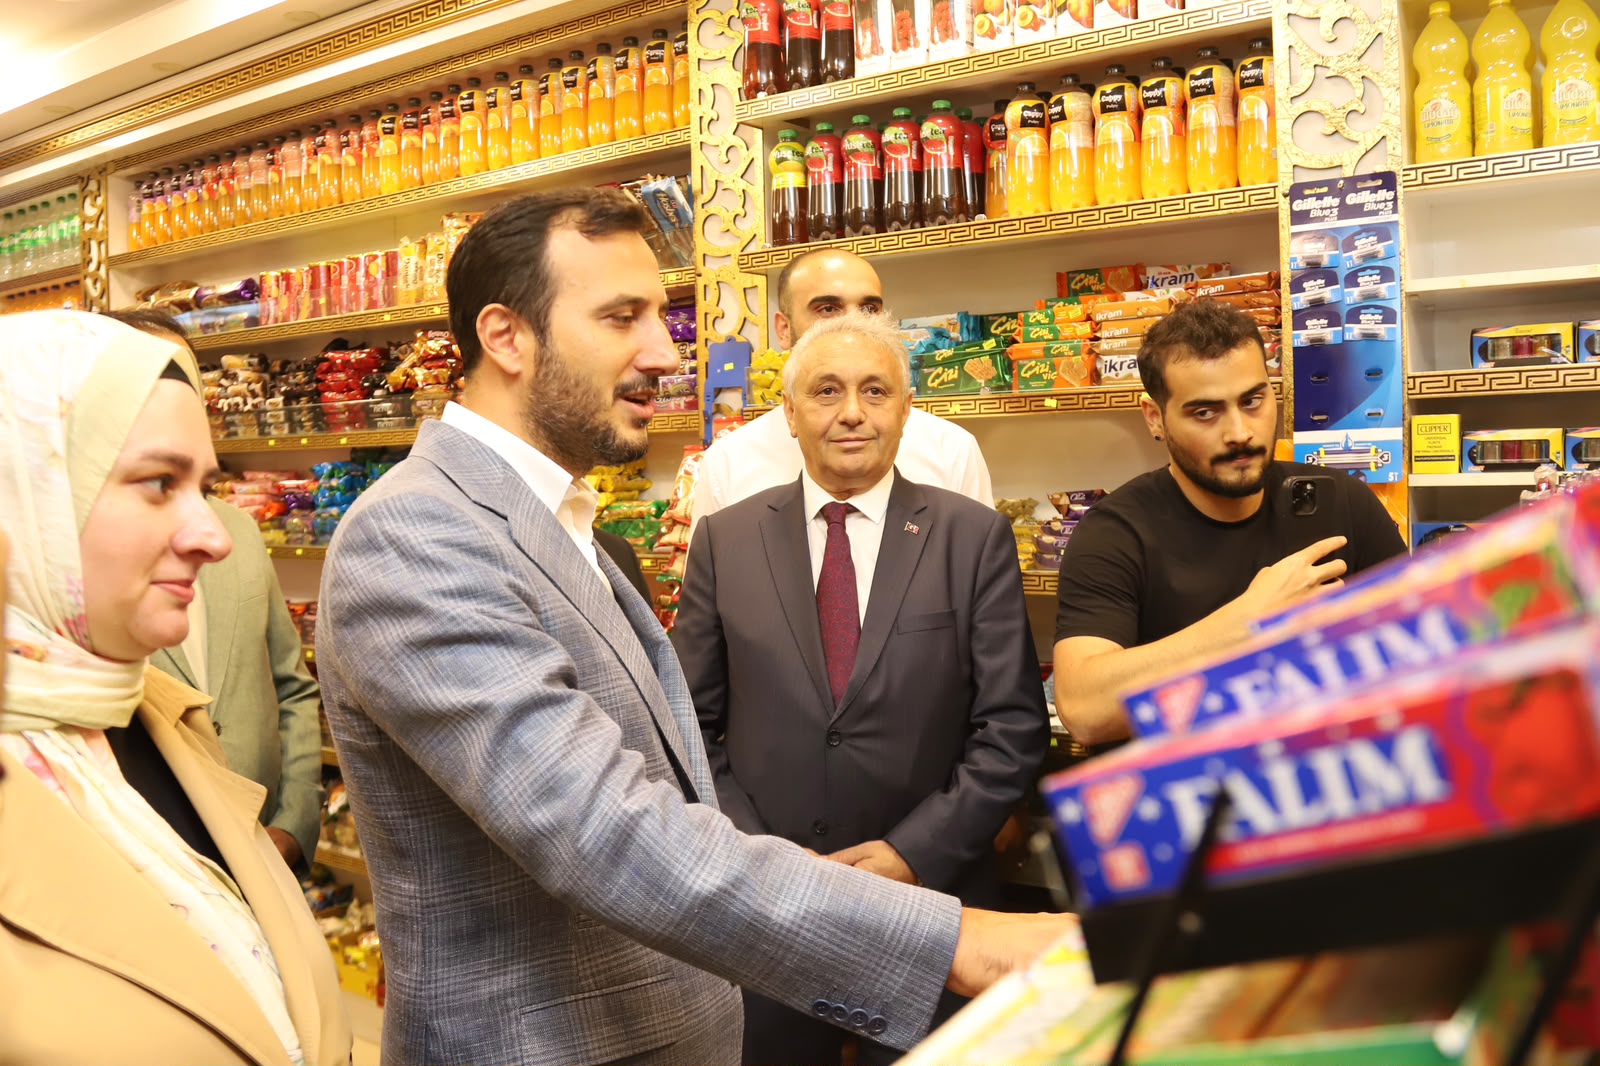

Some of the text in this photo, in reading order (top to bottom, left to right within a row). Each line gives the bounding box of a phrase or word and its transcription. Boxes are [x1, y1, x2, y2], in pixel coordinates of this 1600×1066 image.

[1241, 68, 1260, 78] Cappy
[1190, 79, 1210, 87] Cappy
[1101, 94, 1123, 102] Cappy
[1143, 89, 1161, 98] Cappy
[1022, 109, 1044, 119] Cappy
[1291, 195, 1342, 212] Gillette
[1345, 189, 1396, 205] Gillette
[1145, 270, 1196, 290] ikram
[1020, 360, 1051, 379] Çizi
[1103, 356, 1139, 375] ikra
[926, 365, 960, 389] Çizi
[1419, 424, 1449, 433] CLIPPER
